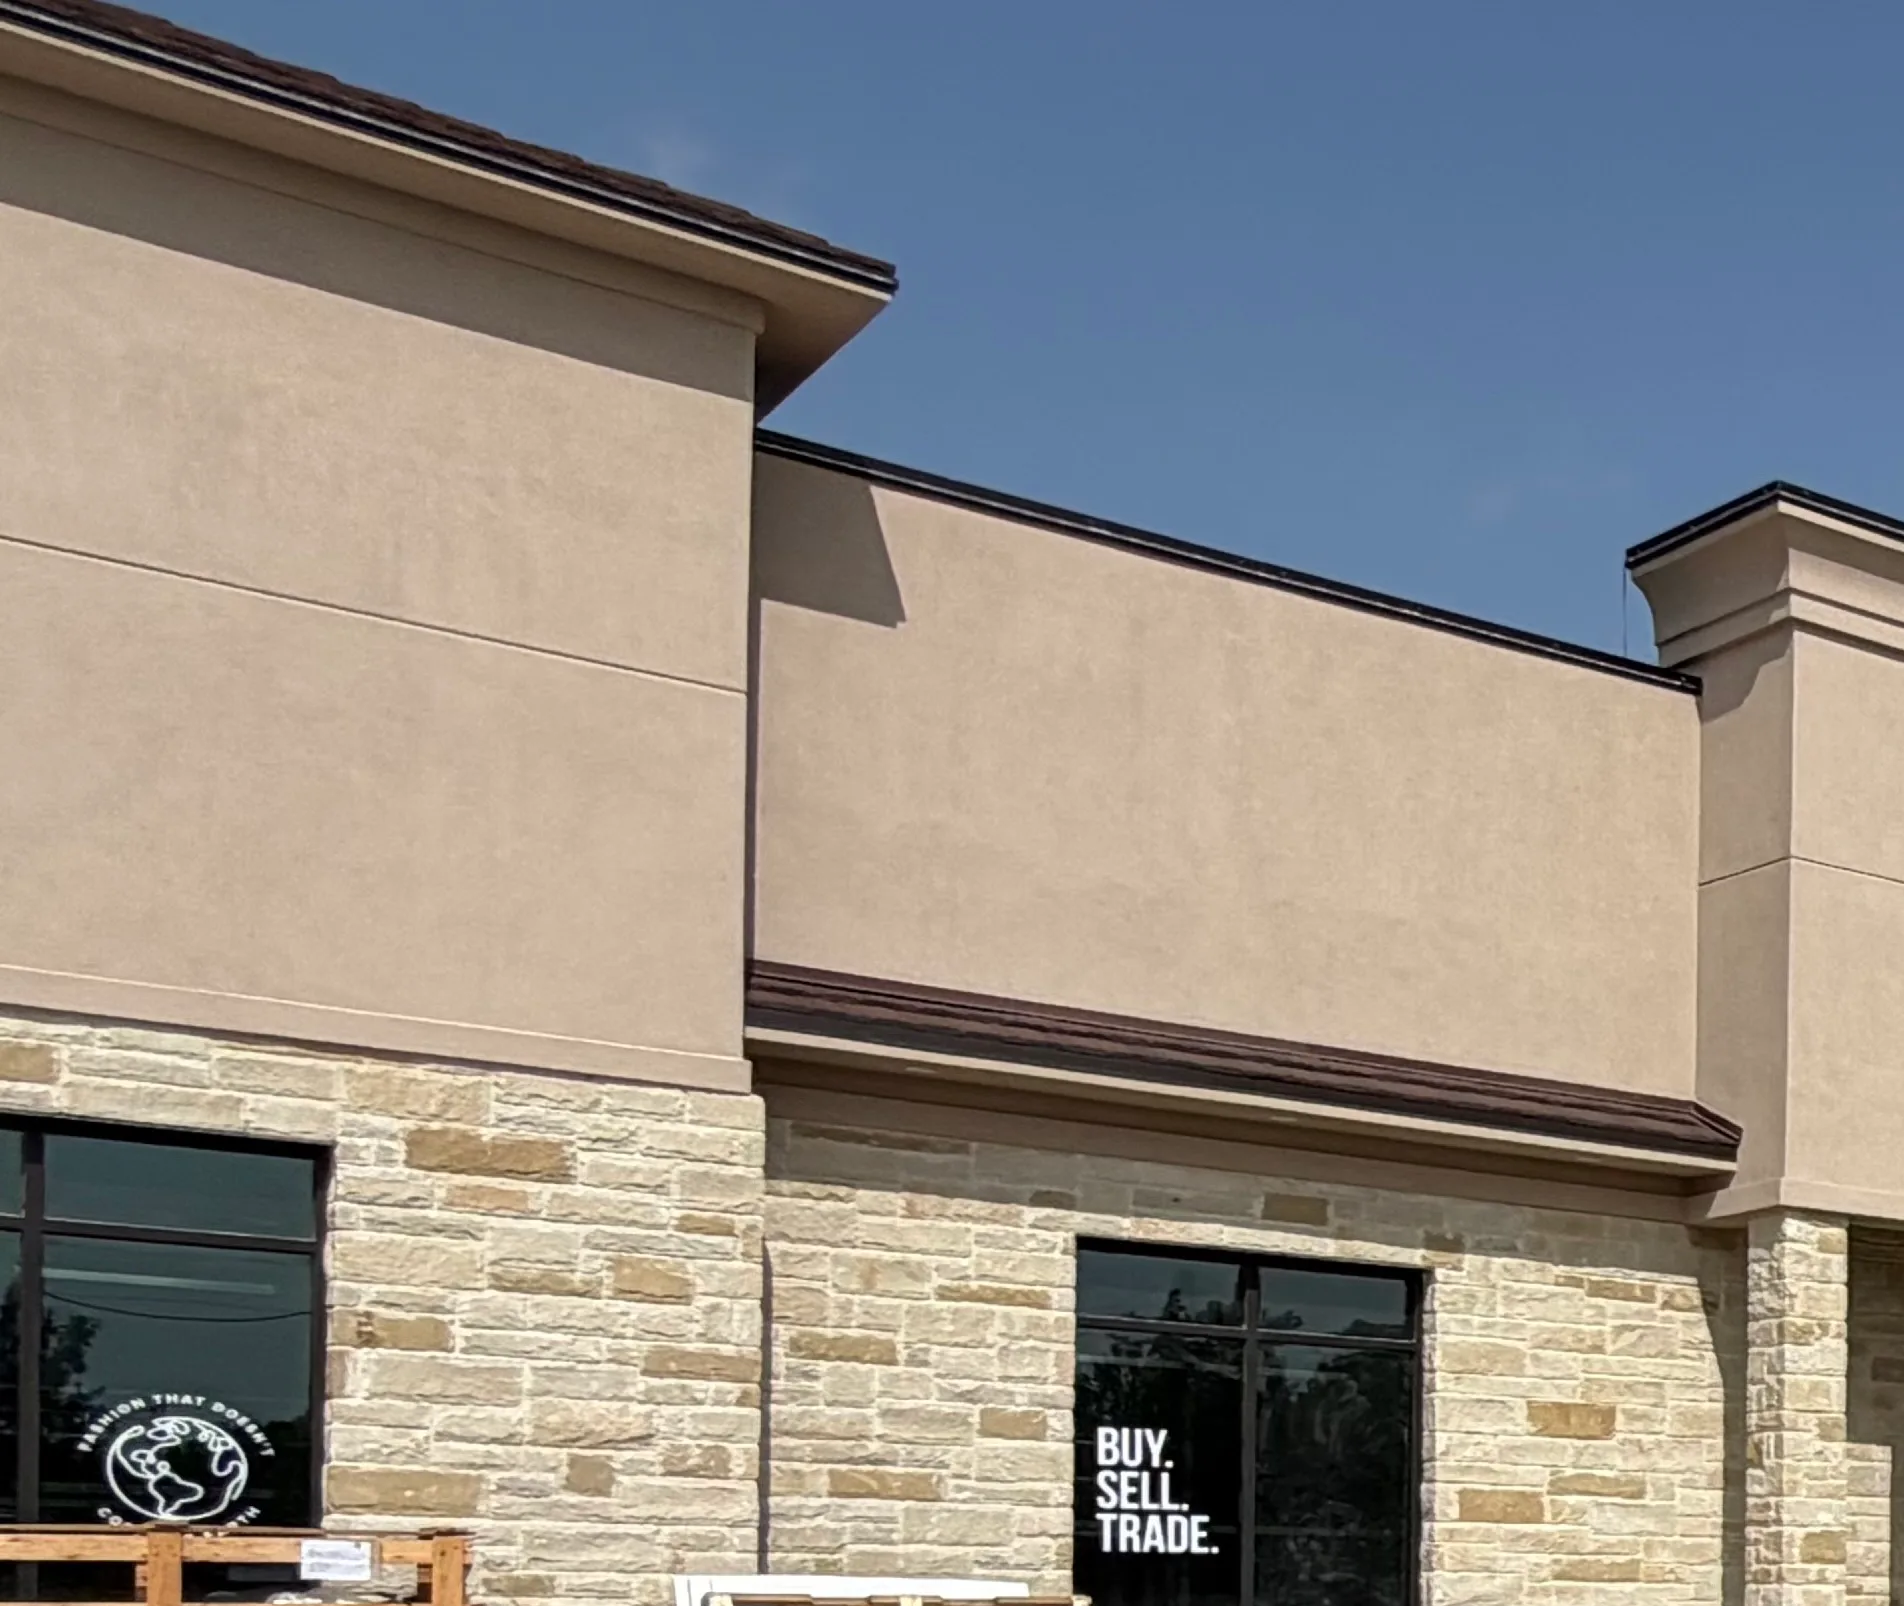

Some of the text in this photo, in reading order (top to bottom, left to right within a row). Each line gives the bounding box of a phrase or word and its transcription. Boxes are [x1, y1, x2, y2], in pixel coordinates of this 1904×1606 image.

[76, 1393, 276, 1457] FASHION THAT DOESN'T
[1096, 1426, 1174, 1469] BUY.
[1095, 1470, 1190, 1512] SELL.
[1095, 1512, 1220, 1555] TRADE.
